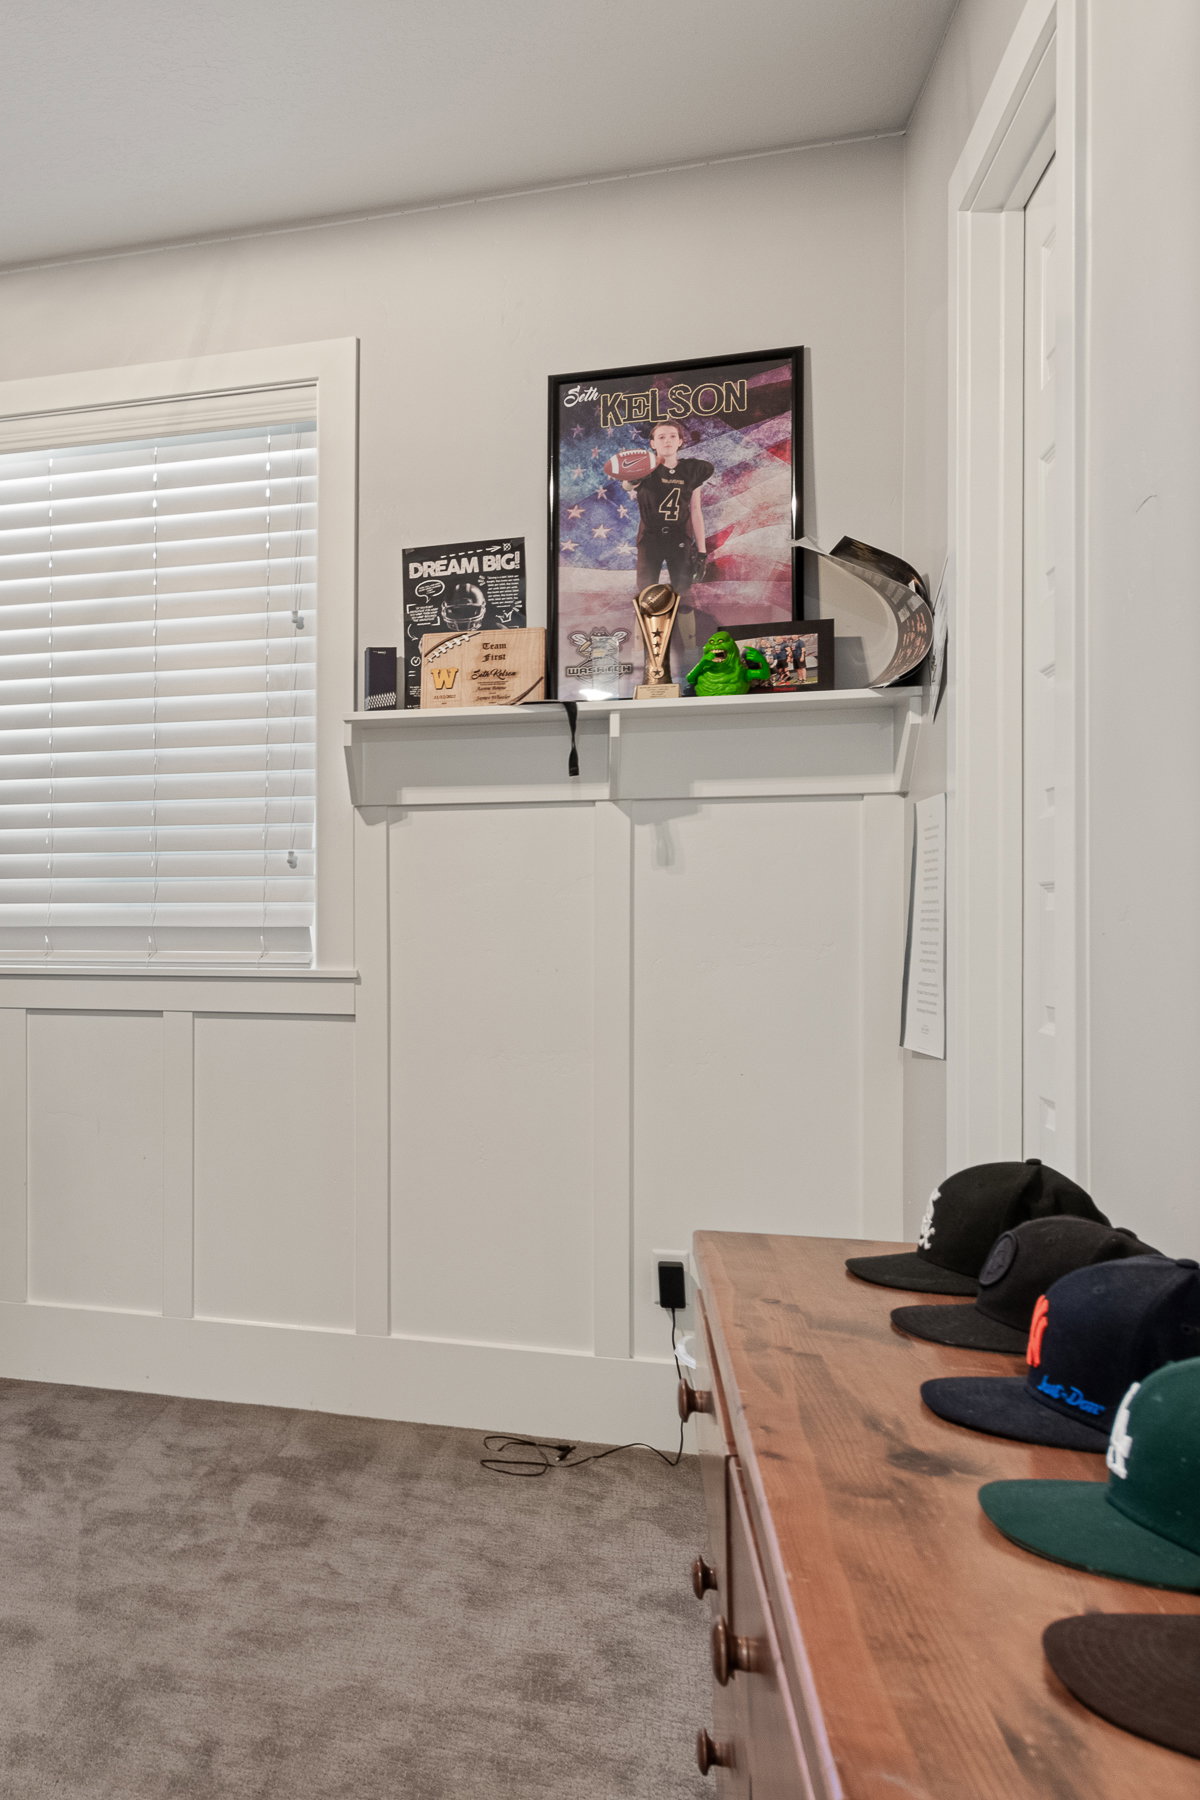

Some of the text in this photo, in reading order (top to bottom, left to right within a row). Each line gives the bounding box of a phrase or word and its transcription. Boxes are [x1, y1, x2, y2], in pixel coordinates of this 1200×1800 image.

[563, 379, 748, 428] Seth KELSON
[659, 487, 681, 521] 4
[408, 550, 521, 579] DREAM BIG!
[481, 642, 507, 650] Team
[481, 653, 506, 662] First
[430, 667, 460, 690] W
